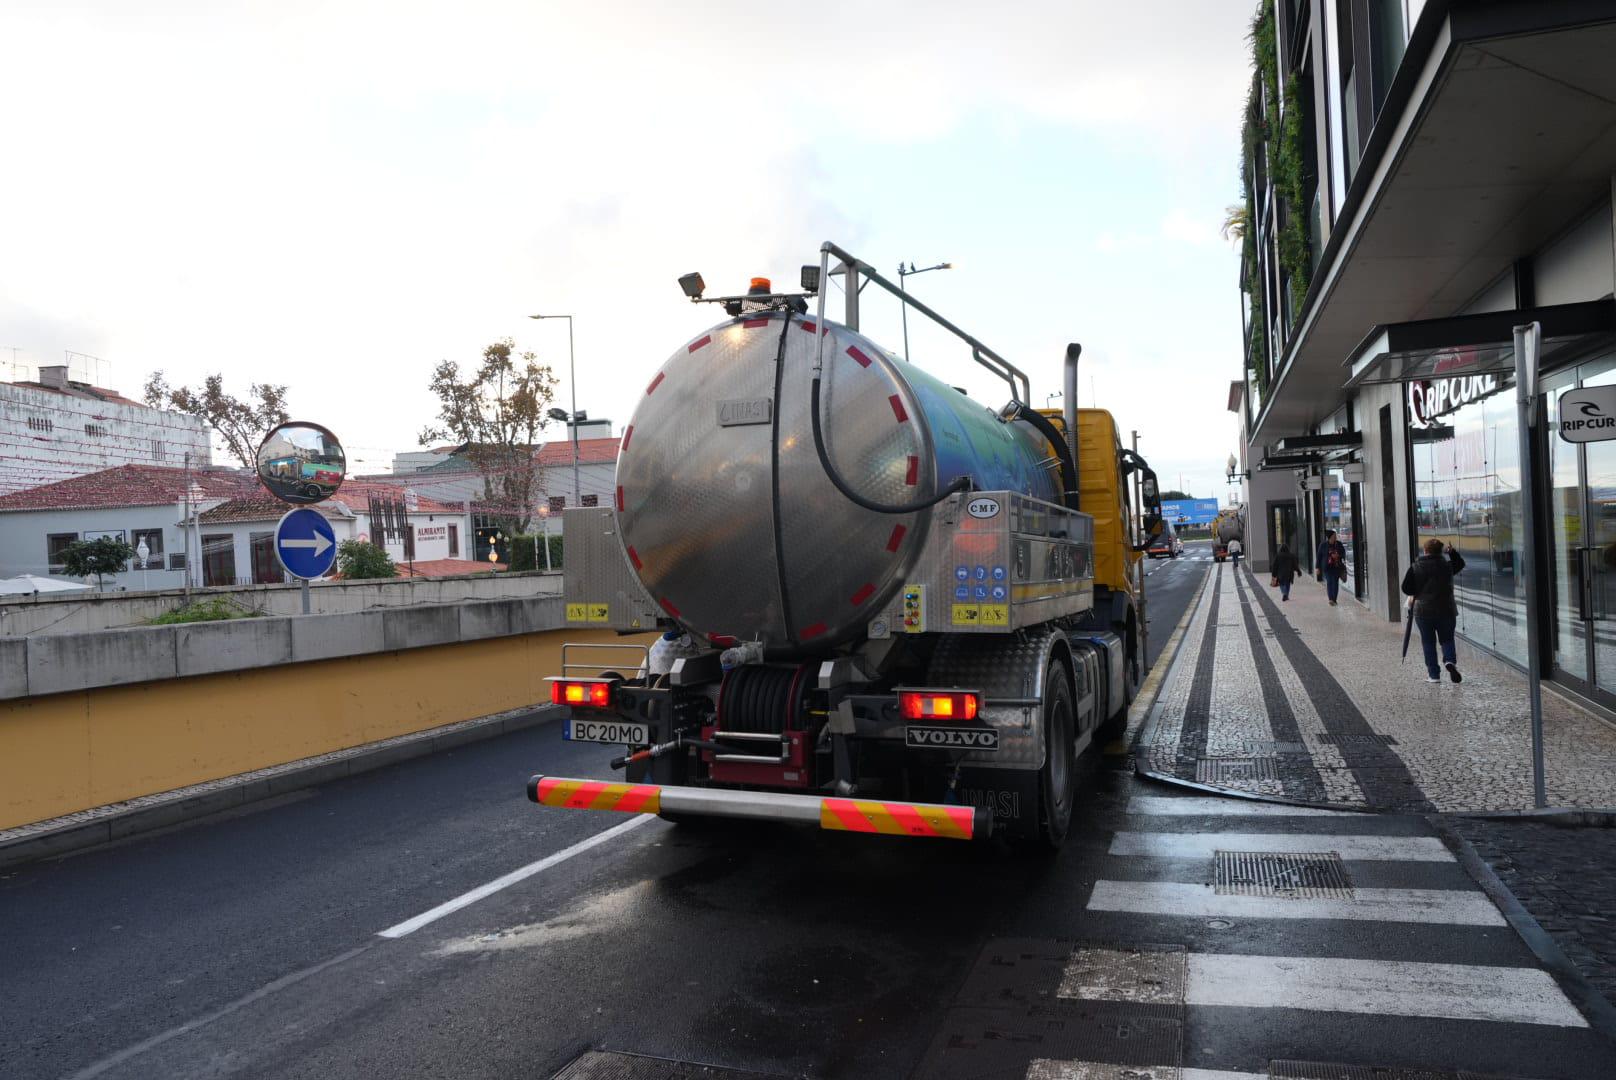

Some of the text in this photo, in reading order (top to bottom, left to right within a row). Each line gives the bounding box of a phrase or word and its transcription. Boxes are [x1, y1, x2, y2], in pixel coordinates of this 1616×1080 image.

[1425, 377, 1448, 419] RIP
[1562, 417, 1616, 431] RIP CUR
[970, 504, 997, 513] CMF
[909, 730, 995, 746] VOLVO
